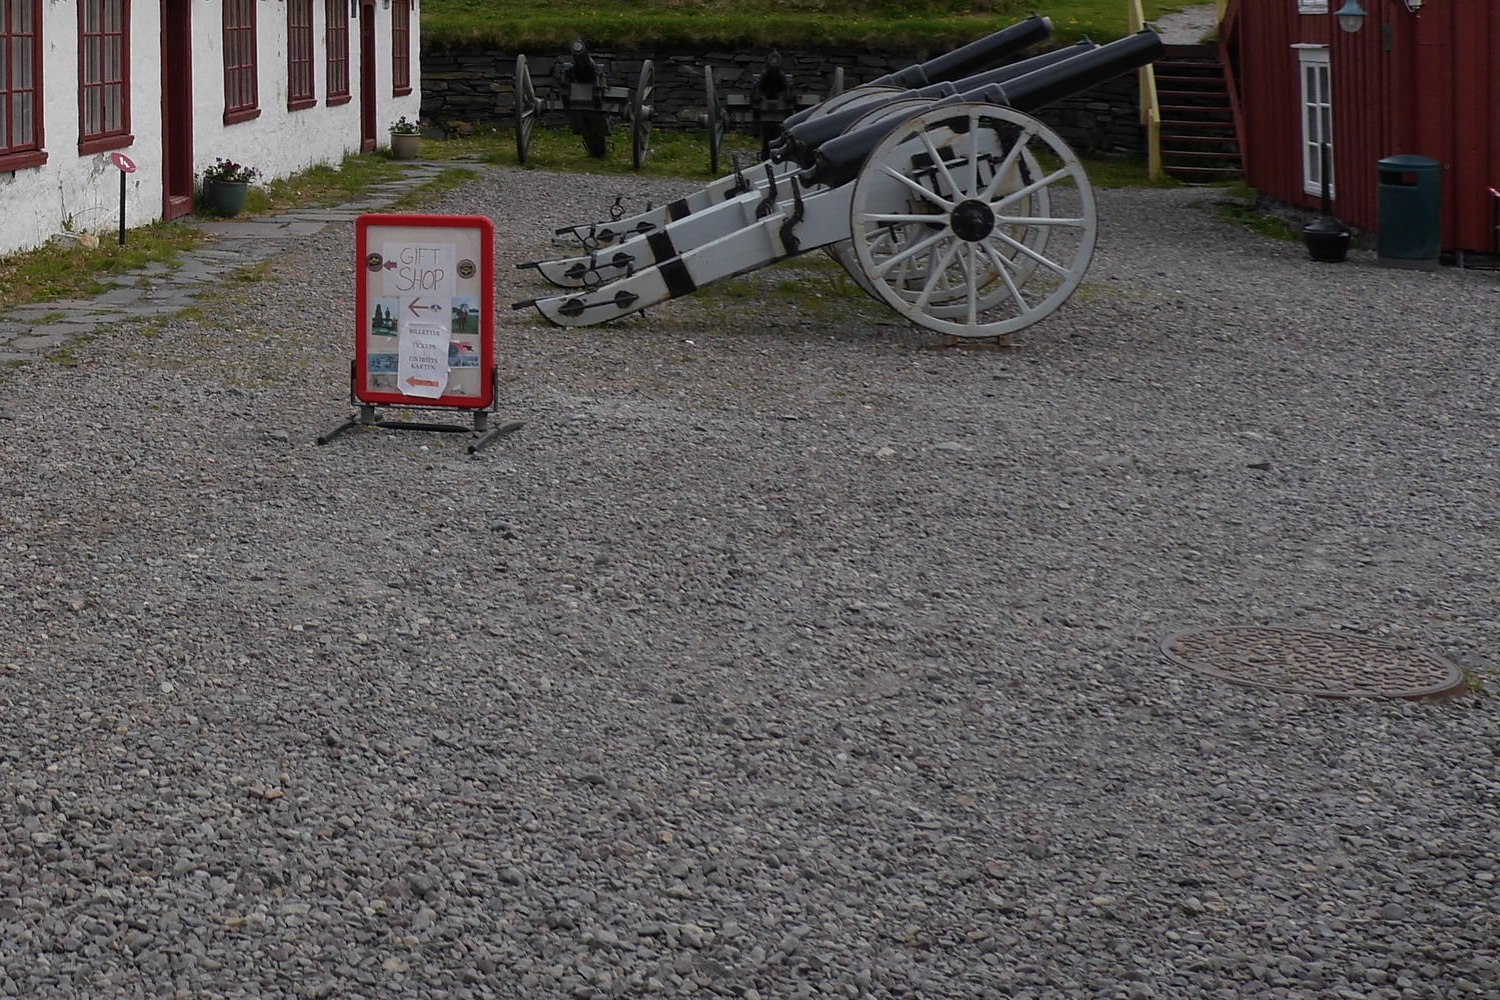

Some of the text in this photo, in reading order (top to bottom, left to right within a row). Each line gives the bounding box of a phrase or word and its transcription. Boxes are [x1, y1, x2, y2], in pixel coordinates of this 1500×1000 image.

[400, 247, 441, 265] GIFT
[396, 266, 444, 291] SHOP
[408, 328, 441, 337] BILLETTER
[410, 363, 436, 371] KARTEN
